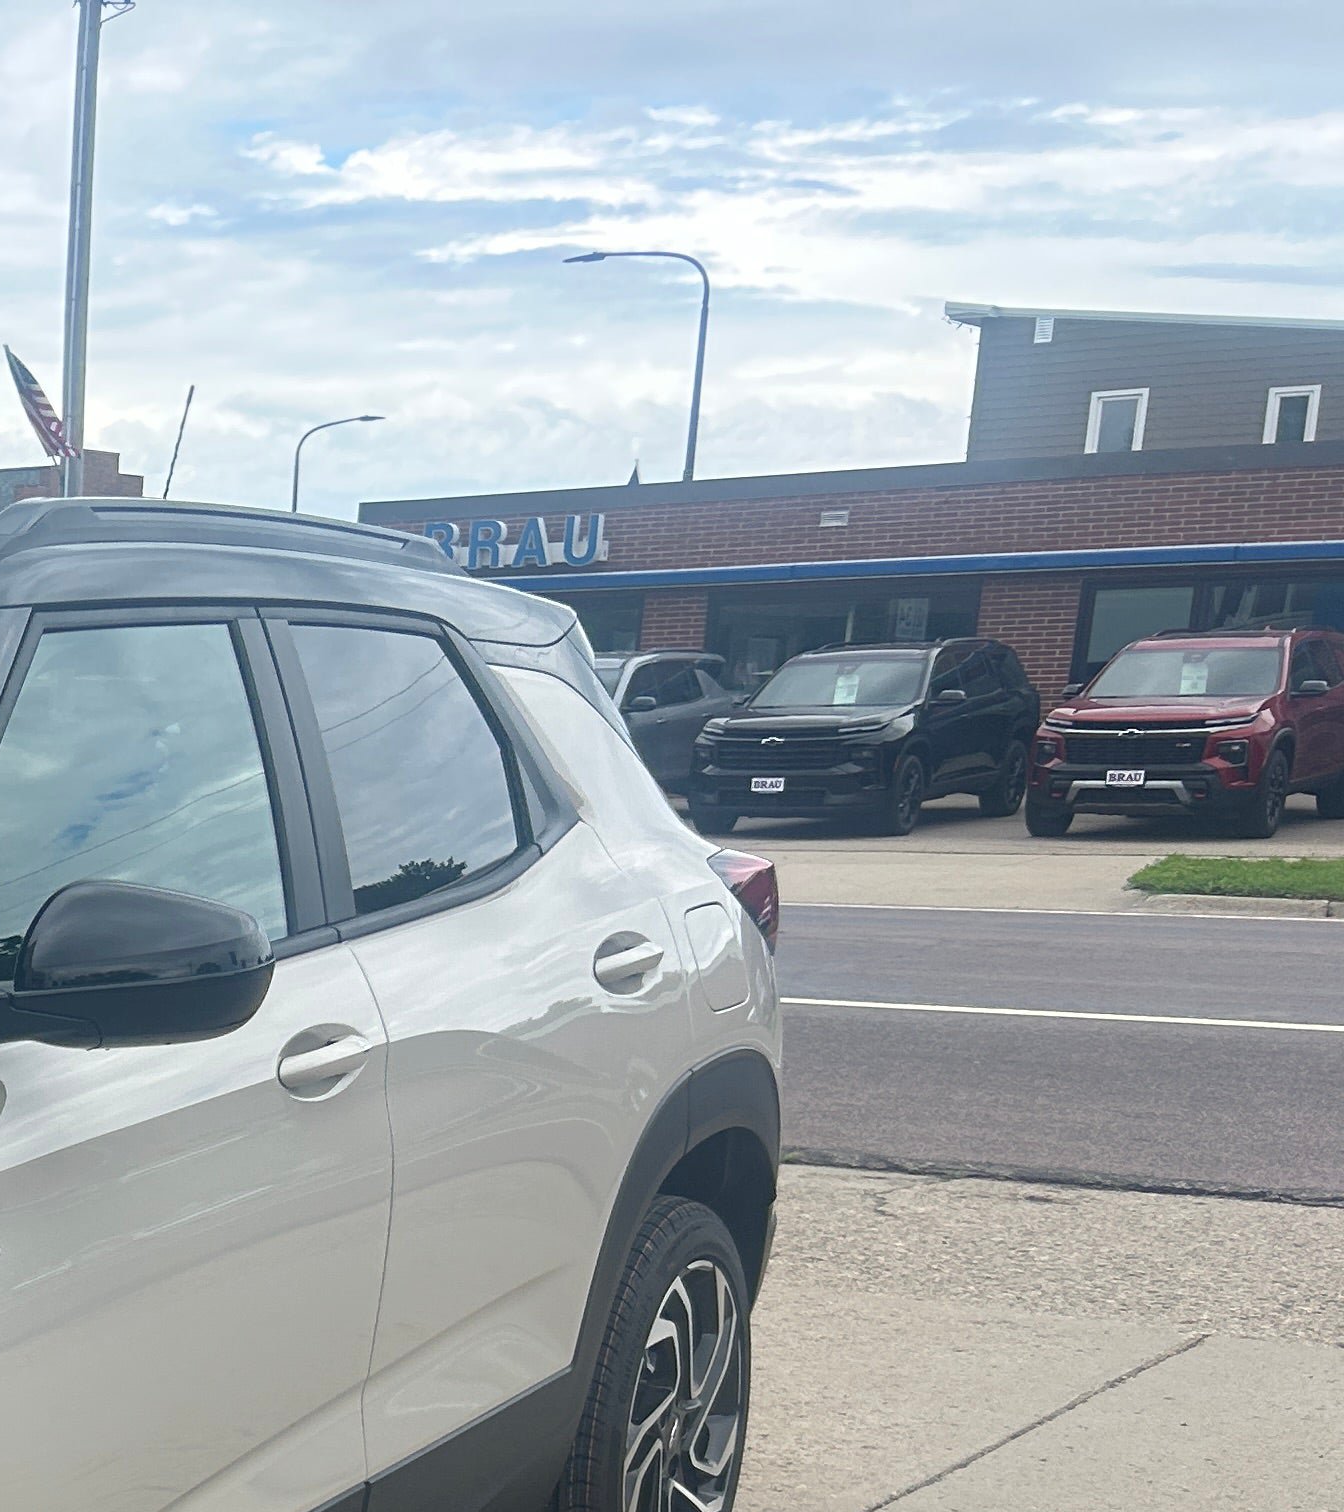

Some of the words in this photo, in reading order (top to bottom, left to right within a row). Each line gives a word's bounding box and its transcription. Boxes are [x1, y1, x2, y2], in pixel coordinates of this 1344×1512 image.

[425, 513, 604, 569] BRAU
[1108, 772, 1143, 783] BRAU
[753, 780, 783, 790] BRAU
